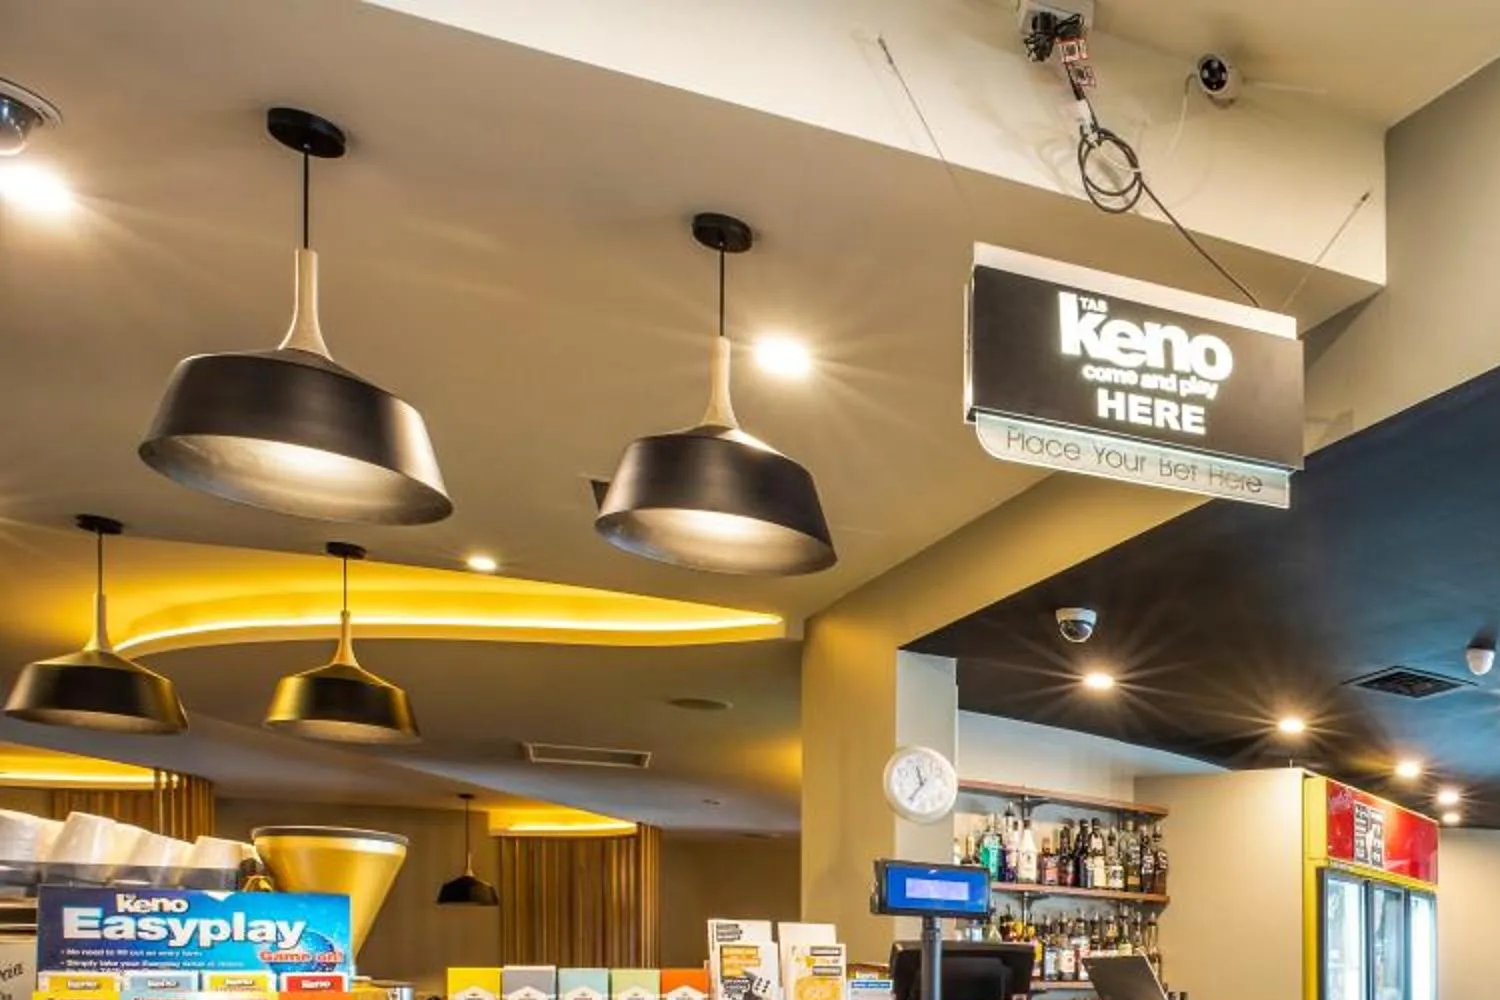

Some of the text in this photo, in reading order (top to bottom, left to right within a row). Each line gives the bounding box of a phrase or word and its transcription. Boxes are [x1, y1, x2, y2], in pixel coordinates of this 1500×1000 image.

[1082, 363, 1218, 400] come and play
[1097, 387, 1206, 436] HERE
[1007, 427, 1263, 493] Place Your Bet Here
[63, 906, 306, 949] Easyplay
